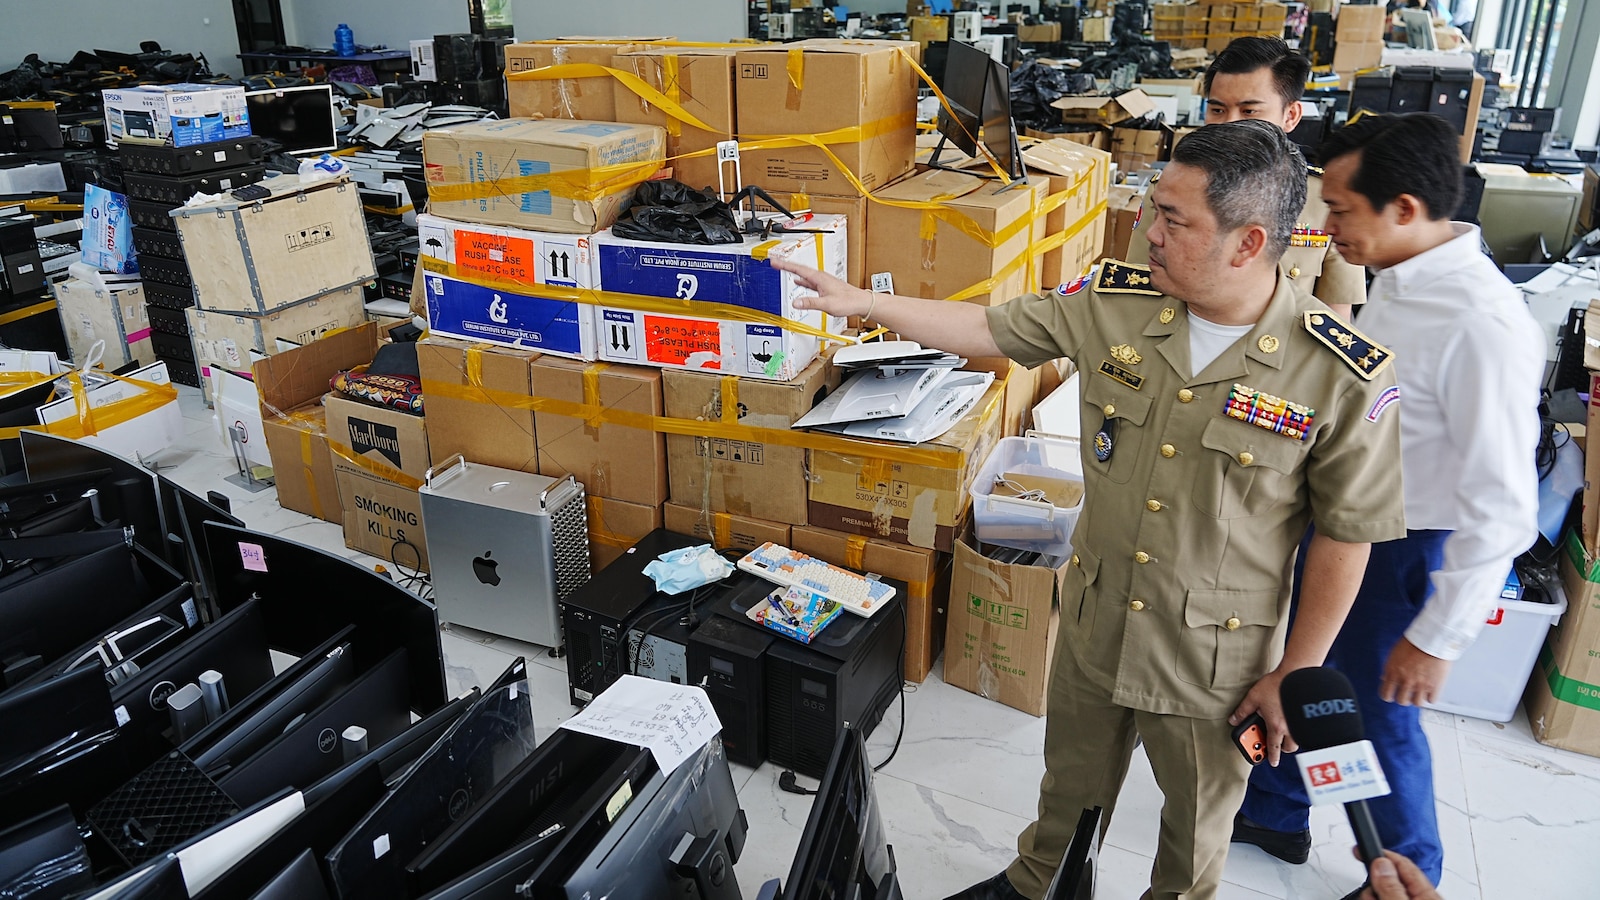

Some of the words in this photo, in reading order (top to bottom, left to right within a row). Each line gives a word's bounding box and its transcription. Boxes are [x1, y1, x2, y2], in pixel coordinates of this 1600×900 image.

[104, 93, 122, 101] EPSON
[172, 95, 193, 103] EPSON
[475, 151, 487, 212] PHILIPES
[471, 240, 508, 253] VACCINE
[464, 251, 487, 261] RUSH
[642, 257, 654, 265] LTD.
[654, 257, 665, 266] PVT.
[665, 258, 680, 267] INDIA
[680, 259, 687, 267] OF
[687, 260, 713, 269] INSTITUTE
[713, 262, 732, 271] SERUM
[464, 323, 479, 331] SERUM
[480, 325, 500, 334] INSTITUTE
[506, 329, 520, 337] INDIA
[348, 422, 399, 453] Marlboro
[354, 495, 418, 526] SMOKING
[841, 516, 872, 528] PREMIUM
[367, 519, 406, 541] KILLS
[1302, 698, 1357, 719] RØDE
